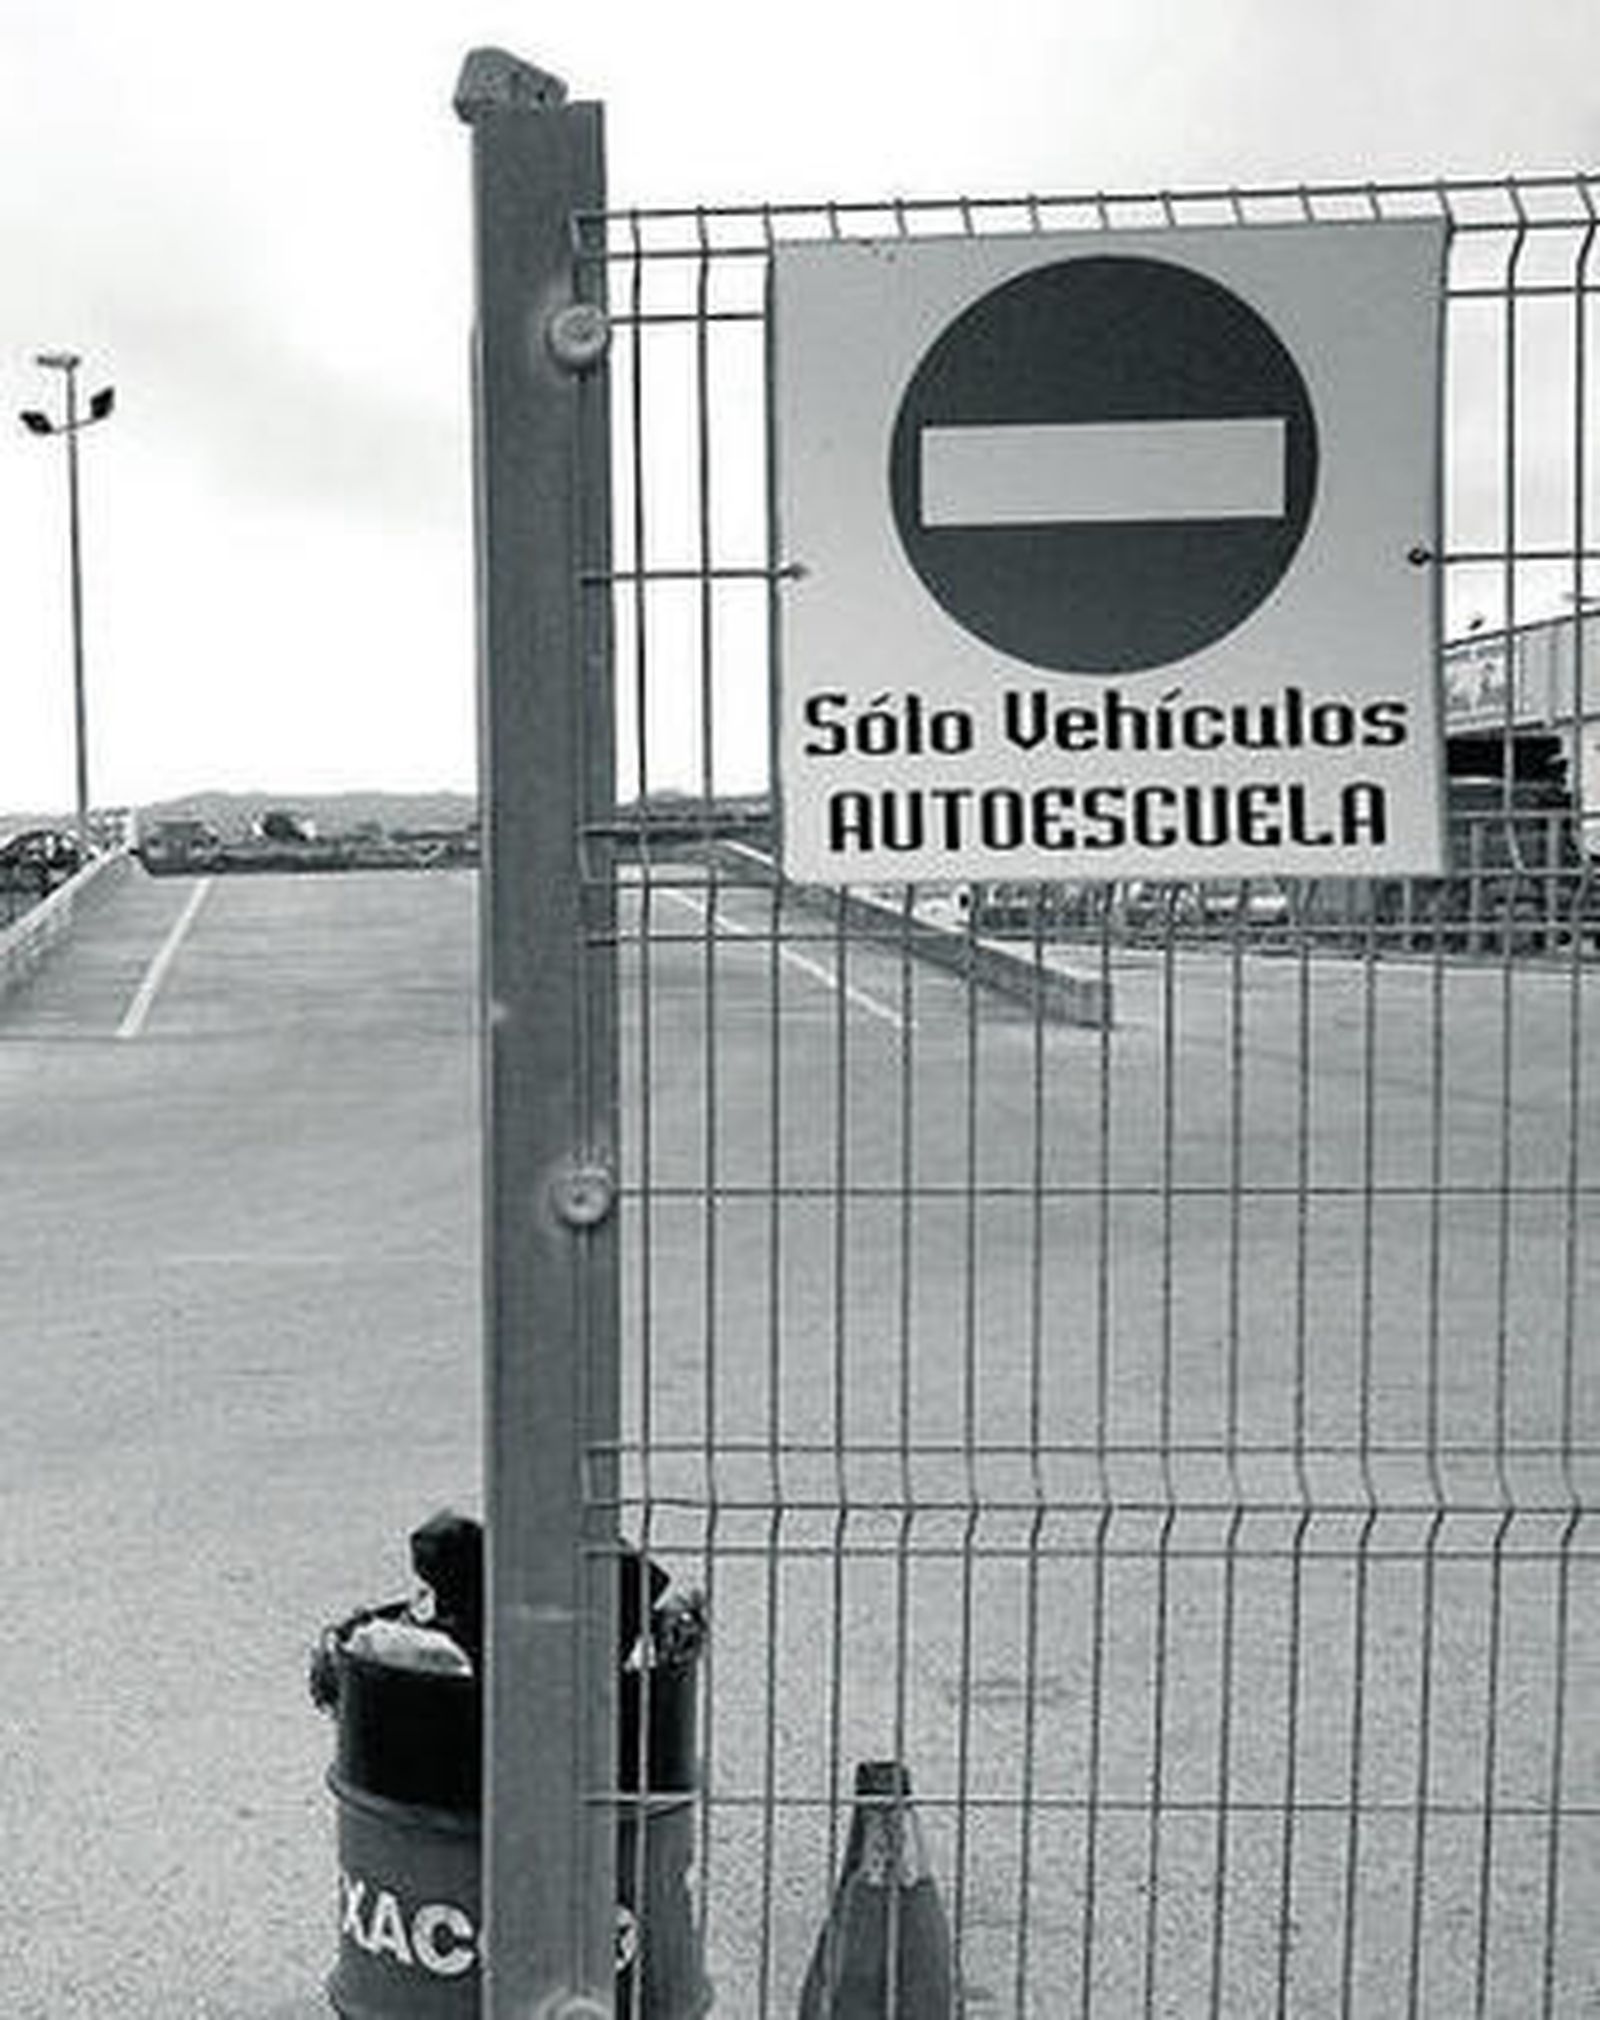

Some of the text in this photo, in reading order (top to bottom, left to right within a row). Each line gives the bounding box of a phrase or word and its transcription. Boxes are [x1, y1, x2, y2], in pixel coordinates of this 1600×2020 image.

[804, 686, 1409, 756] Sólo Vehículos
[829, 782, 1387, 852] AUTOESCUELA
